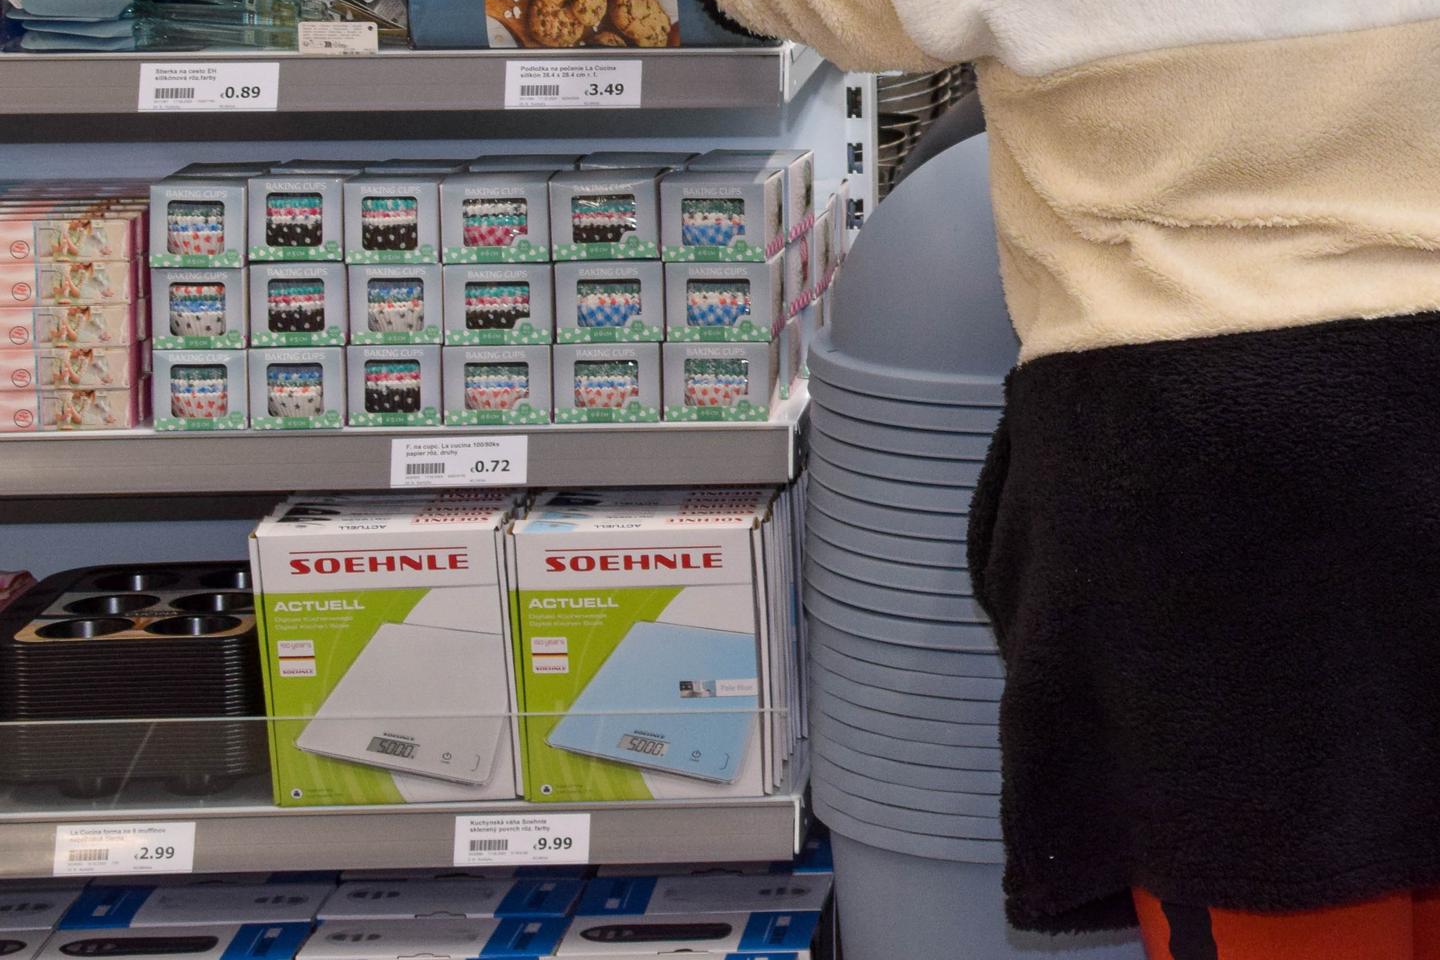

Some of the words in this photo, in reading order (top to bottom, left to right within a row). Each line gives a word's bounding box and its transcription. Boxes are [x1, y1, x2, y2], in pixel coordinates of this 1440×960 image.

[266, 182, 301, 191] BAKING
[304, 181, 327, 190] CUPS
[361, 185, 396, 194] BAKING
[399, 184, 421, 193] CUPS
[465, 186, 497, 196] BAKING
[500, 185, 526, 194] CUPS
[166, 189, 202, 199] BAKING
[205, 189, 228, 199] CUPS
[683, 188, 715, 197] BAKING
[718, 187, 742, 196] CUPS
[168, 272, 203, 281] BAKING
[205, 271, 228, 280] CUPS
[267, 268, 302, 277] BAKING
[304, 267, 328, 276] CUPS
[366, 268, 400, 277] BAKING
[403, 267, 426, 276] CUPS
[467, 271, 501, 280] BAKING
[504, 270, 528, 279] CUPS
[579, 268, 612, 277] BAKING
[614, 267, 639, 276] CUPS
[689, 268, 722, 277] BAKING
[724, 267, 748, 276] CUPS
[265, 352, 300, 361] BAKING
[302, 352, 325, 361] CUPS
[364, 349, 398, 358] BAKING
[401, 348, 424, 357] CUPS
[465, 351, 499, 360] BAKING
[501, 350, 525, 359] CUPS
[576, 350, 609, 359] BAKING
[611, 348, 636, 358] CUPS
[686, 348, 719, 357] BAKING
[721, 347, 745, 356] CUPS
[169, 353, 203, 363] BAKING
[205, 353, 229, 362] CUPS
[289, 554, 469, 575] SOEHNLE
[545, 552, 723, 572] SOEHNLE
[274, 599, 365, 612] ACTUELL
[528, 597, 619, 609] ACTUELL
